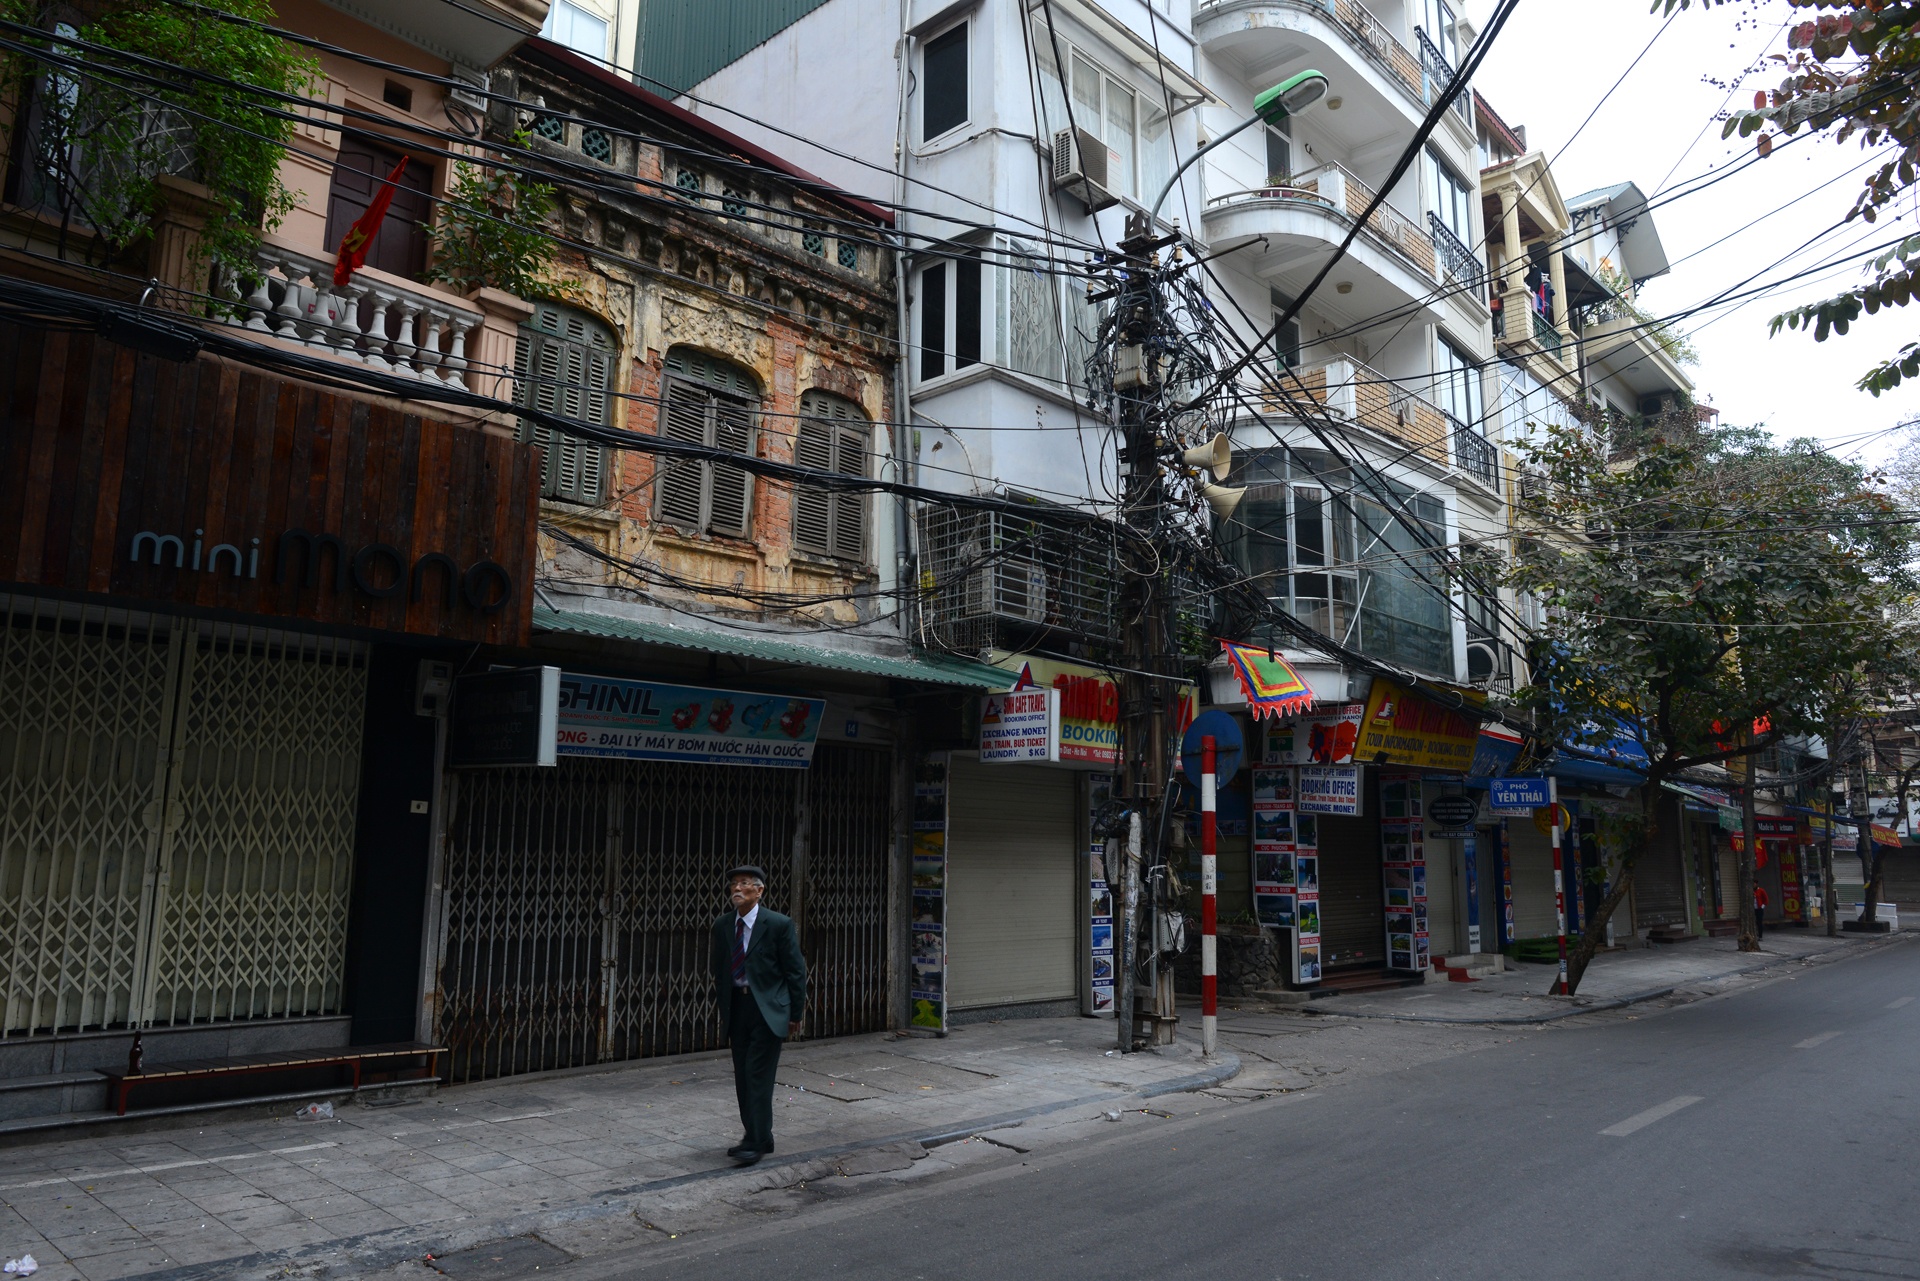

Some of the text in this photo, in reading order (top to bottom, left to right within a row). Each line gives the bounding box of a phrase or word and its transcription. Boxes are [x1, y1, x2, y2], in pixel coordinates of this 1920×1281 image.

[130, 527, 512, 614] mini mono
[1015, 695, 1027, 713] CAFE
[1028, 694, 1046, 712] TRAVEL
[1342, 706, 1361, 714] OFFICE
[848, 724, 856, 733] 14
[983, 726, 1047, 738] EXCHANGE MONEY
[600, 734, 624, 748] ĐẠI
[626, 732, 642, 747] LÝ
[645, 734, 675, 750] MÁY
[678, 738, 706, 752] BƠM
[708, 740, 743, 754] NƯỚC
[745, 741, 770, 756] HÀN
[774, 744, 805, 757] QUỐC
[982, 738, 1046, 749] AIR, TRAIN, BUS TICKET
[1366, 733, 1383, 747] TOUR
[1384, 734, 1425, 752] INFORMATION
[1427, 741, 1454, 756] BOOKING
[1454, 744, 1472, 758] OFFICE
[983, 748, 1045, 758] LAUNDRY. $KG
[1336, 769, 1355, 777] TOURIST
[1301, 779, 1355, 795] BOOKING OFFICE
[1510, 782, 1528, 790] PHỐ
[1497, 790, 1542, 802] YÊN THÁI
[1300, 802, 1355, 814] EXCHANGE MONEY
[1774, 822, 1794, 832] Vietnam
